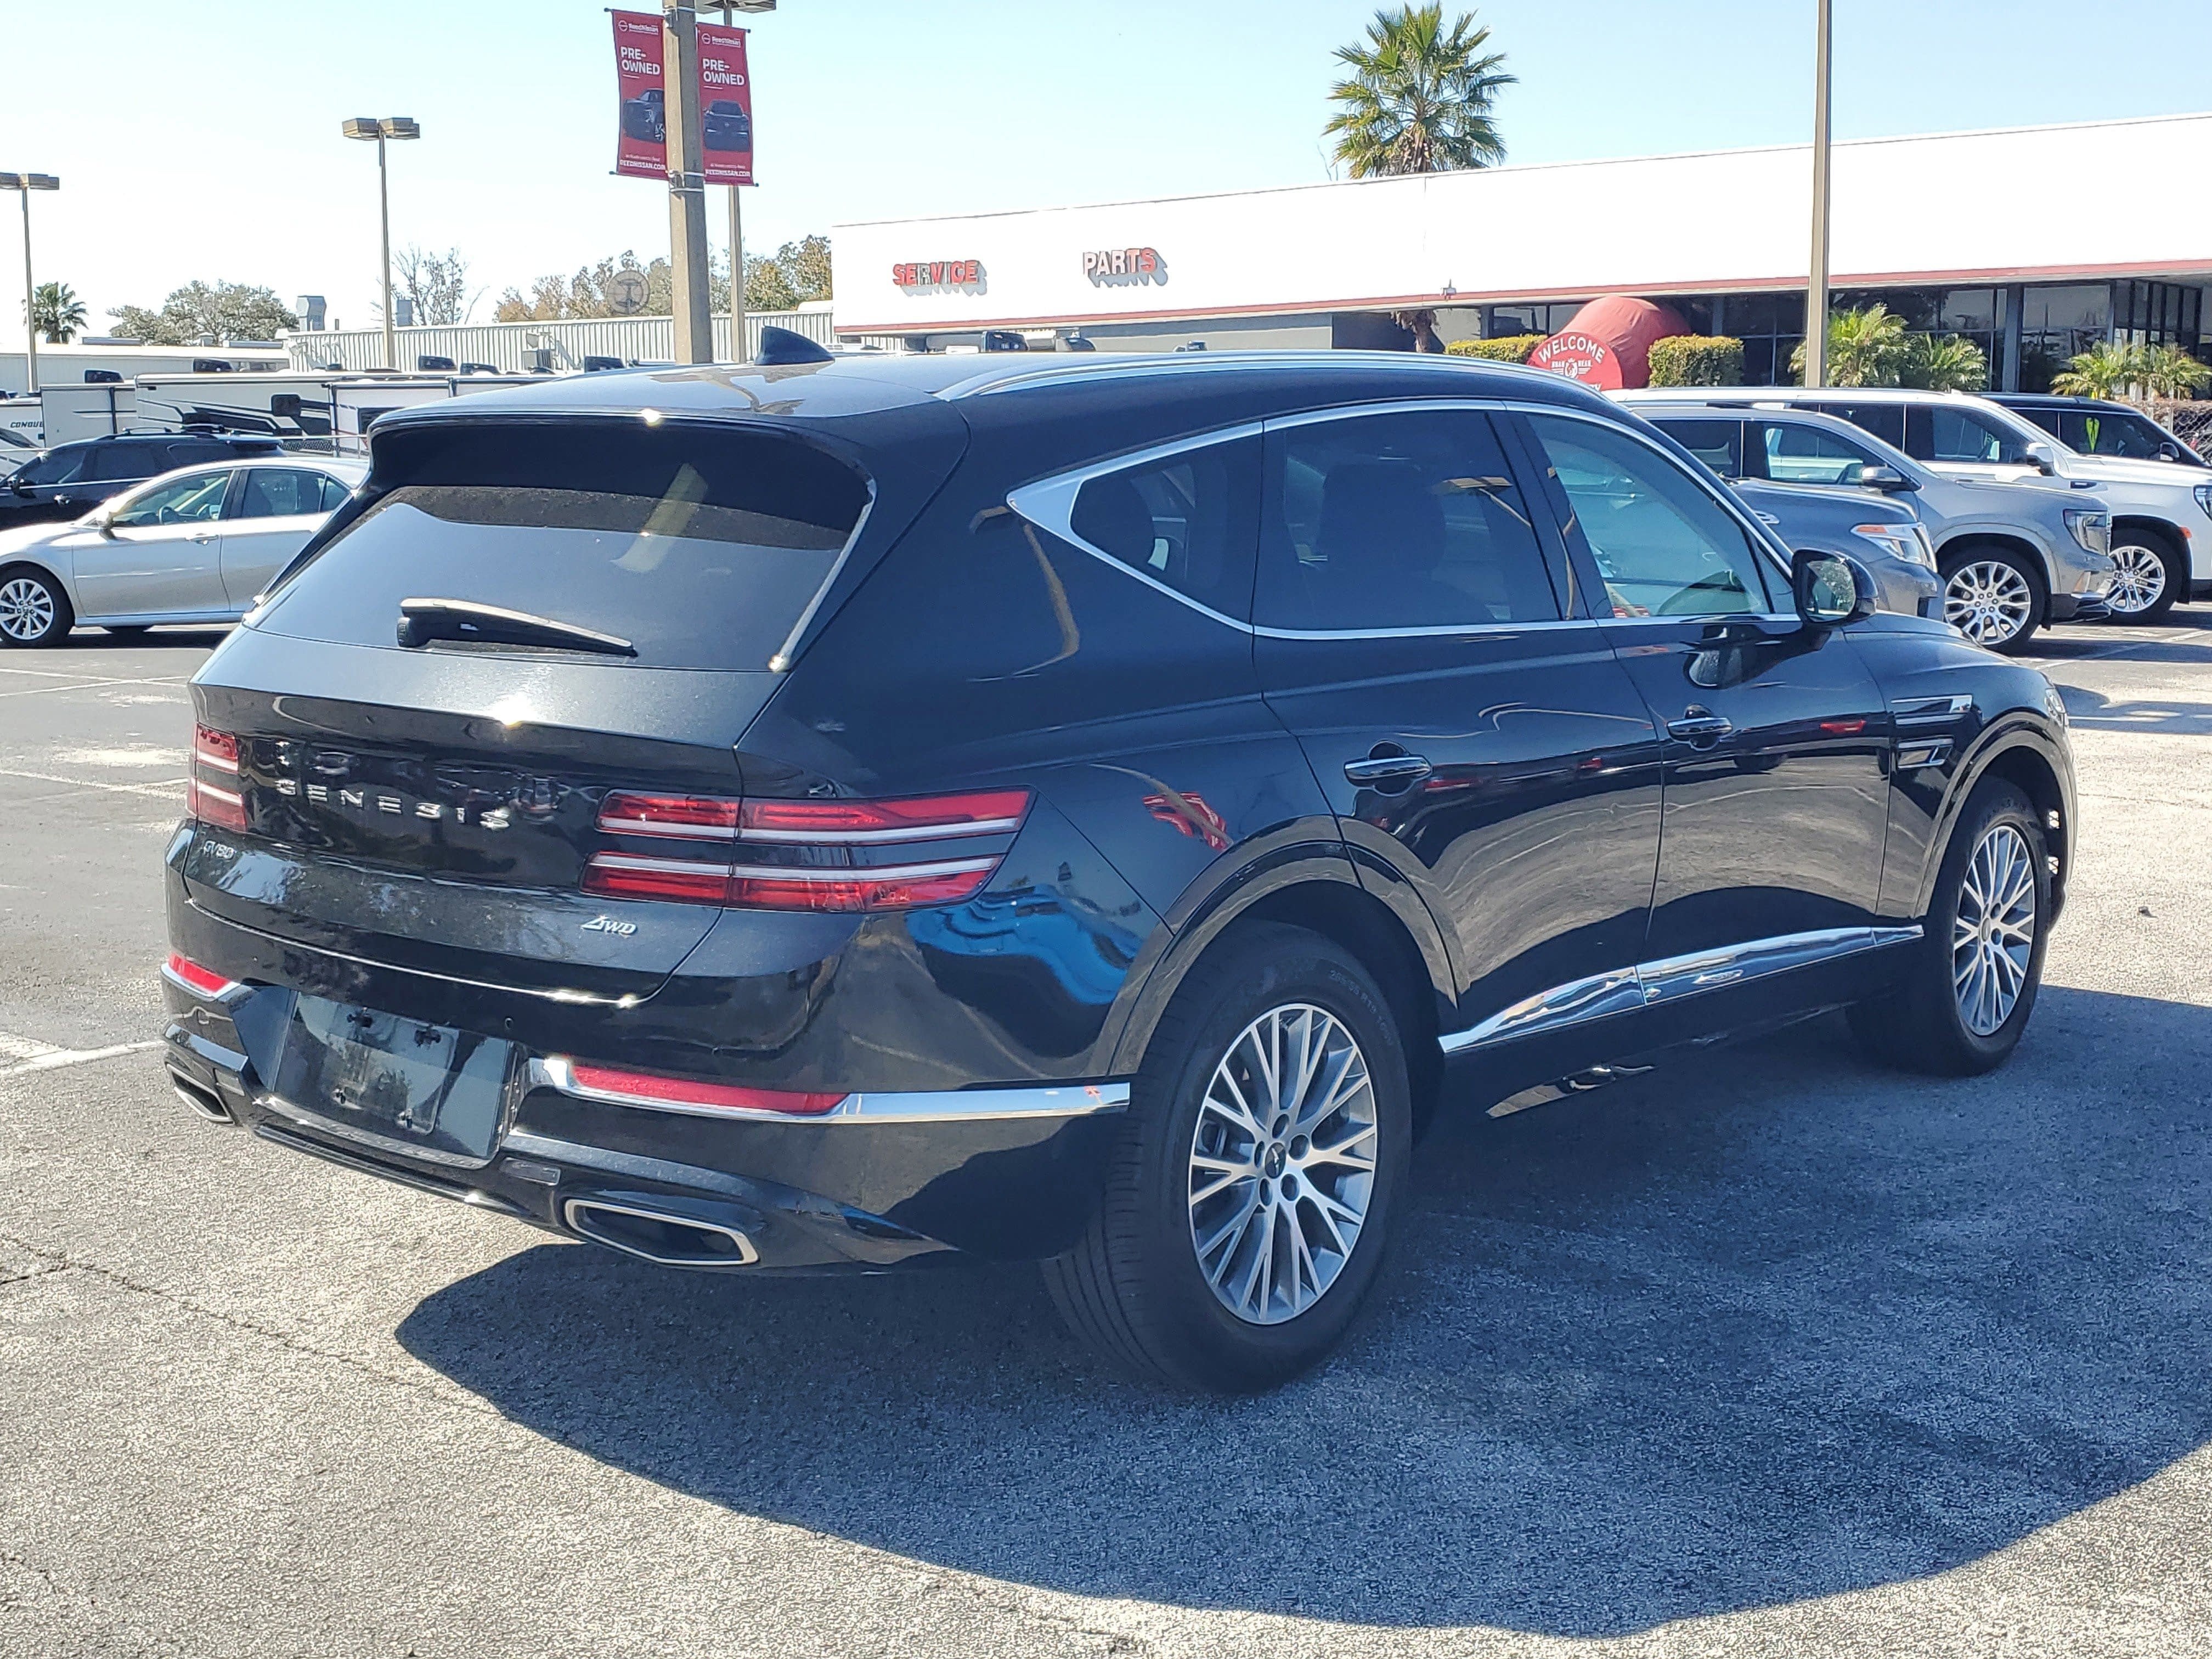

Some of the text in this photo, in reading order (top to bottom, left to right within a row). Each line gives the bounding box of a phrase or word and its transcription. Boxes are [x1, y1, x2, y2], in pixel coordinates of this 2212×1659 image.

[620, 46, 646, 60] PRE-
[622, 59, 660, 75] OWNED
[703, 58, 730, 71] PRE-
[703, 71, 744, 85] OWNED
[1083, 247, 1156, 276] PARTS
[893, 260, 979, 286] SERVICE
[1538, 335, 1606, 363] WELCOME
[275, 778, 510, 829] GENESIS
